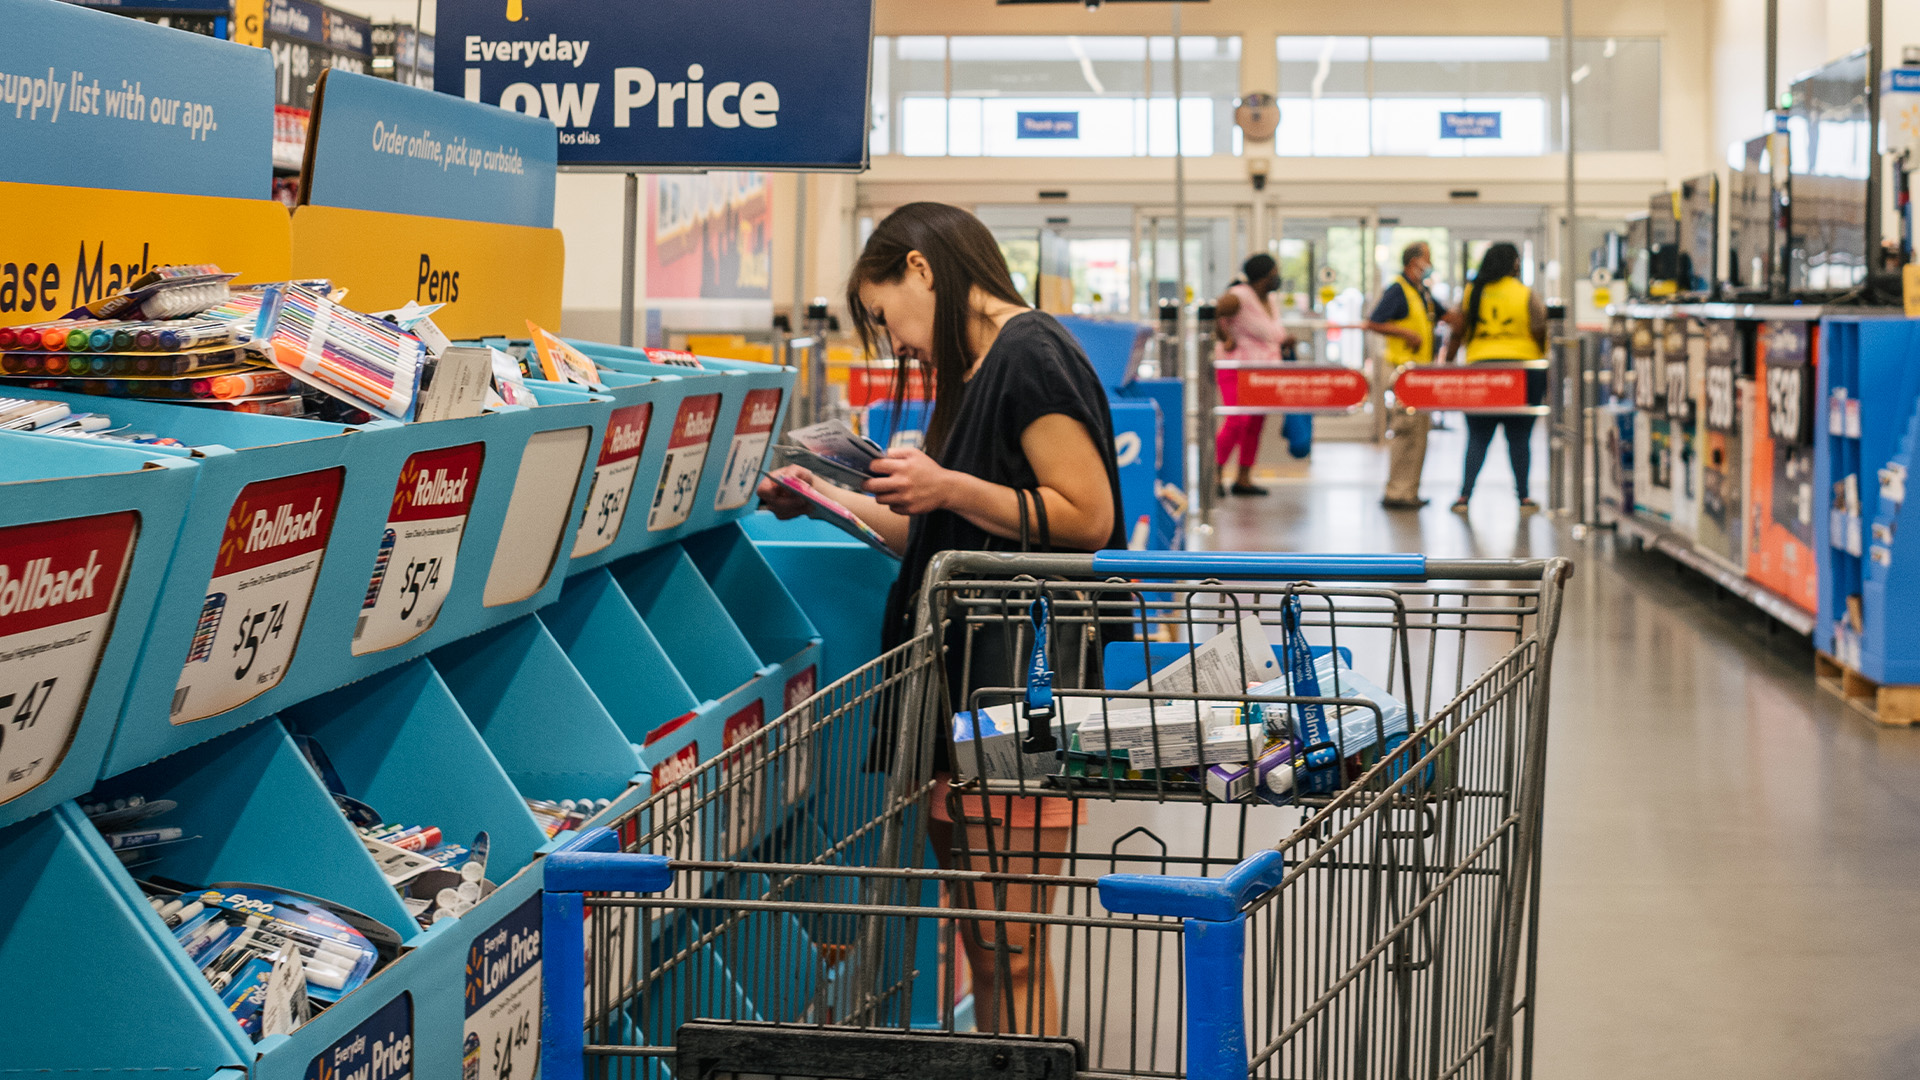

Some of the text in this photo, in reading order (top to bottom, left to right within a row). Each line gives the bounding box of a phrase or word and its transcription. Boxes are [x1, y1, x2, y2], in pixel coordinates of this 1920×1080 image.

[465, 33, 590, 68] Everyday
[69, 71, 100, 115] list
[105, 79, 145, 121] with
[150, 97, 181, 125] our
[182, 101, 217, 141] app.
[614, 63, 780, 128] Price
[372, 120, 524, 176] Order online, pick up curbside.
[560, 131, 600, 145] los días
[0, 262, 60, 312] ase
[418, 254, 460, 302] Pens
[610, 421, 644, 455] Rollback
[411, 467, 468, 507] Rollback
[244, 497, 323, 554] Rollback
[483, 926, 540, 996] Low Price
[484, 929, 508, 955] Everyday
[334, 1034, 367, 1067] Everyday
[372, 1031, 411, 1080] Price
